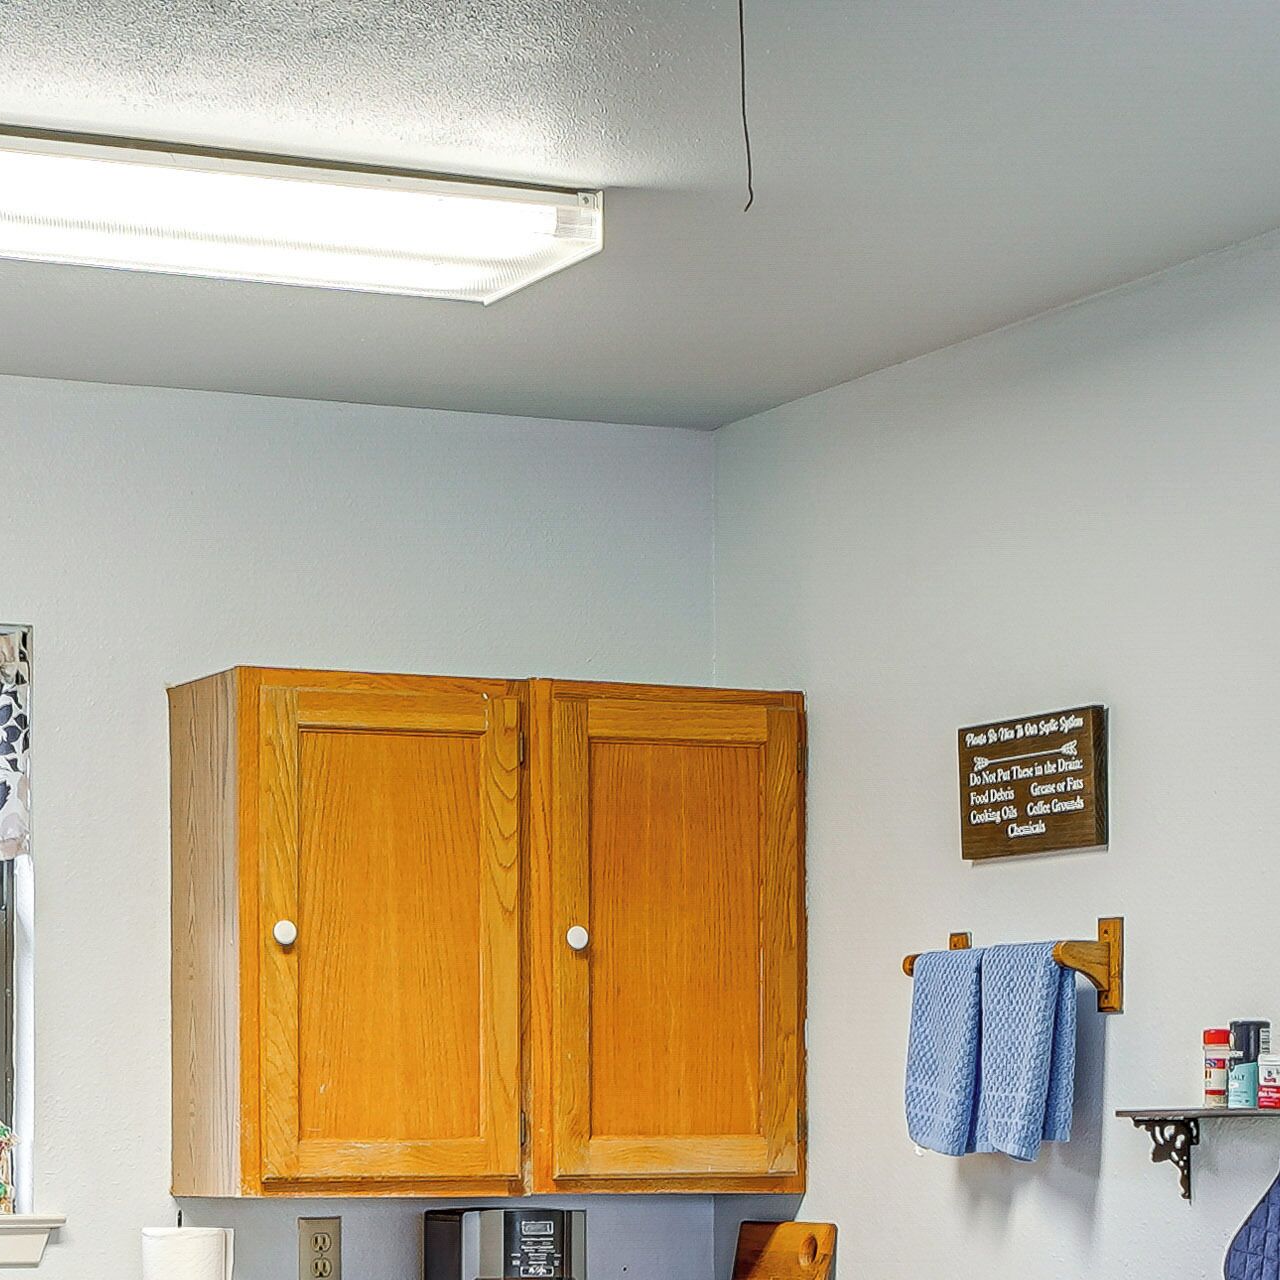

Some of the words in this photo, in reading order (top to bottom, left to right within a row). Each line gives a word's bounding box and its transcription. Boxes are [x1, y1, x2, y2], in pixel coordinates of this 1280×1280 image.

[970, 772, 982, 787] Do
[982, 770, 997, 785] Not
[997, 768, 1011, 782] Put
[1010, 766, 1034, 780] These
[1034, 762, 1043, 776] in
[1043, 760, 1057, 775] the
[970, 789, 989, 806] Food
[990, 786, 1015, 803] Debris
[1030, 782, 1056, 796] Grease
[1056, 781, 1066, 793] or
[1066, 776, 1084, 792] Fats
[970, 808, 1001, 824] Cooking
[1001, 805, 1018, 820] Oils
[1027, 800, 1051, 816] Coffee
[1051, 795, 1084, 813] Grounds
[1007, 820, 1046, 838] Chemicals
